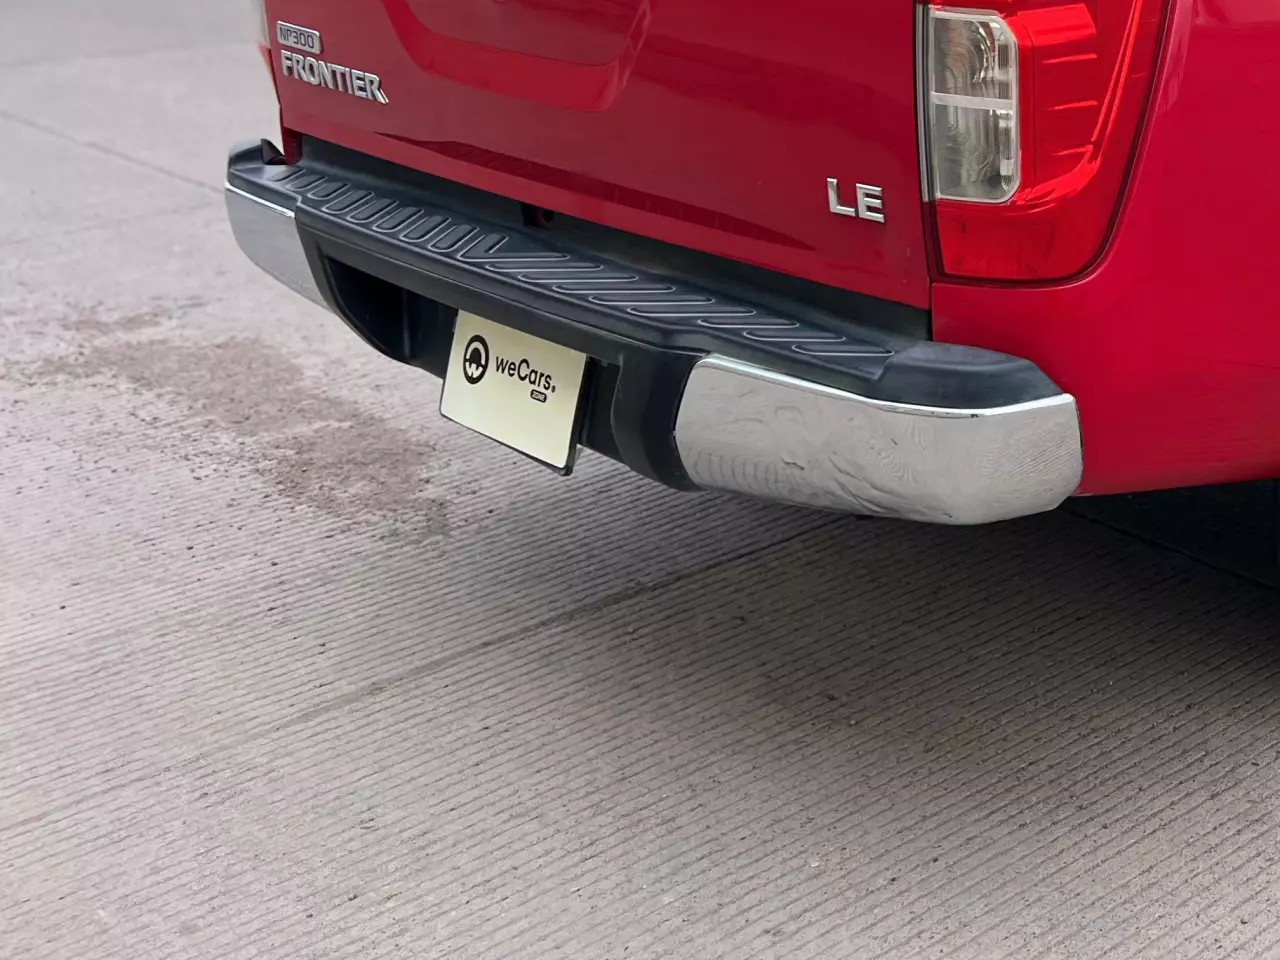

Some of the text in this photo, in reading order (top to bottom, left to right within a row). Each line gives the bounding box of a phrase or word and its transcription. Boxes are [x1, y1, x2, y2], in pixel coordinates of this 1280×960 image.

[279, 26, 315, 50] NP300
[281, 49, 389, 104] FRONTIER
[826, 177, 885, 223] LE
[495, 355, 552, 391] weCars
